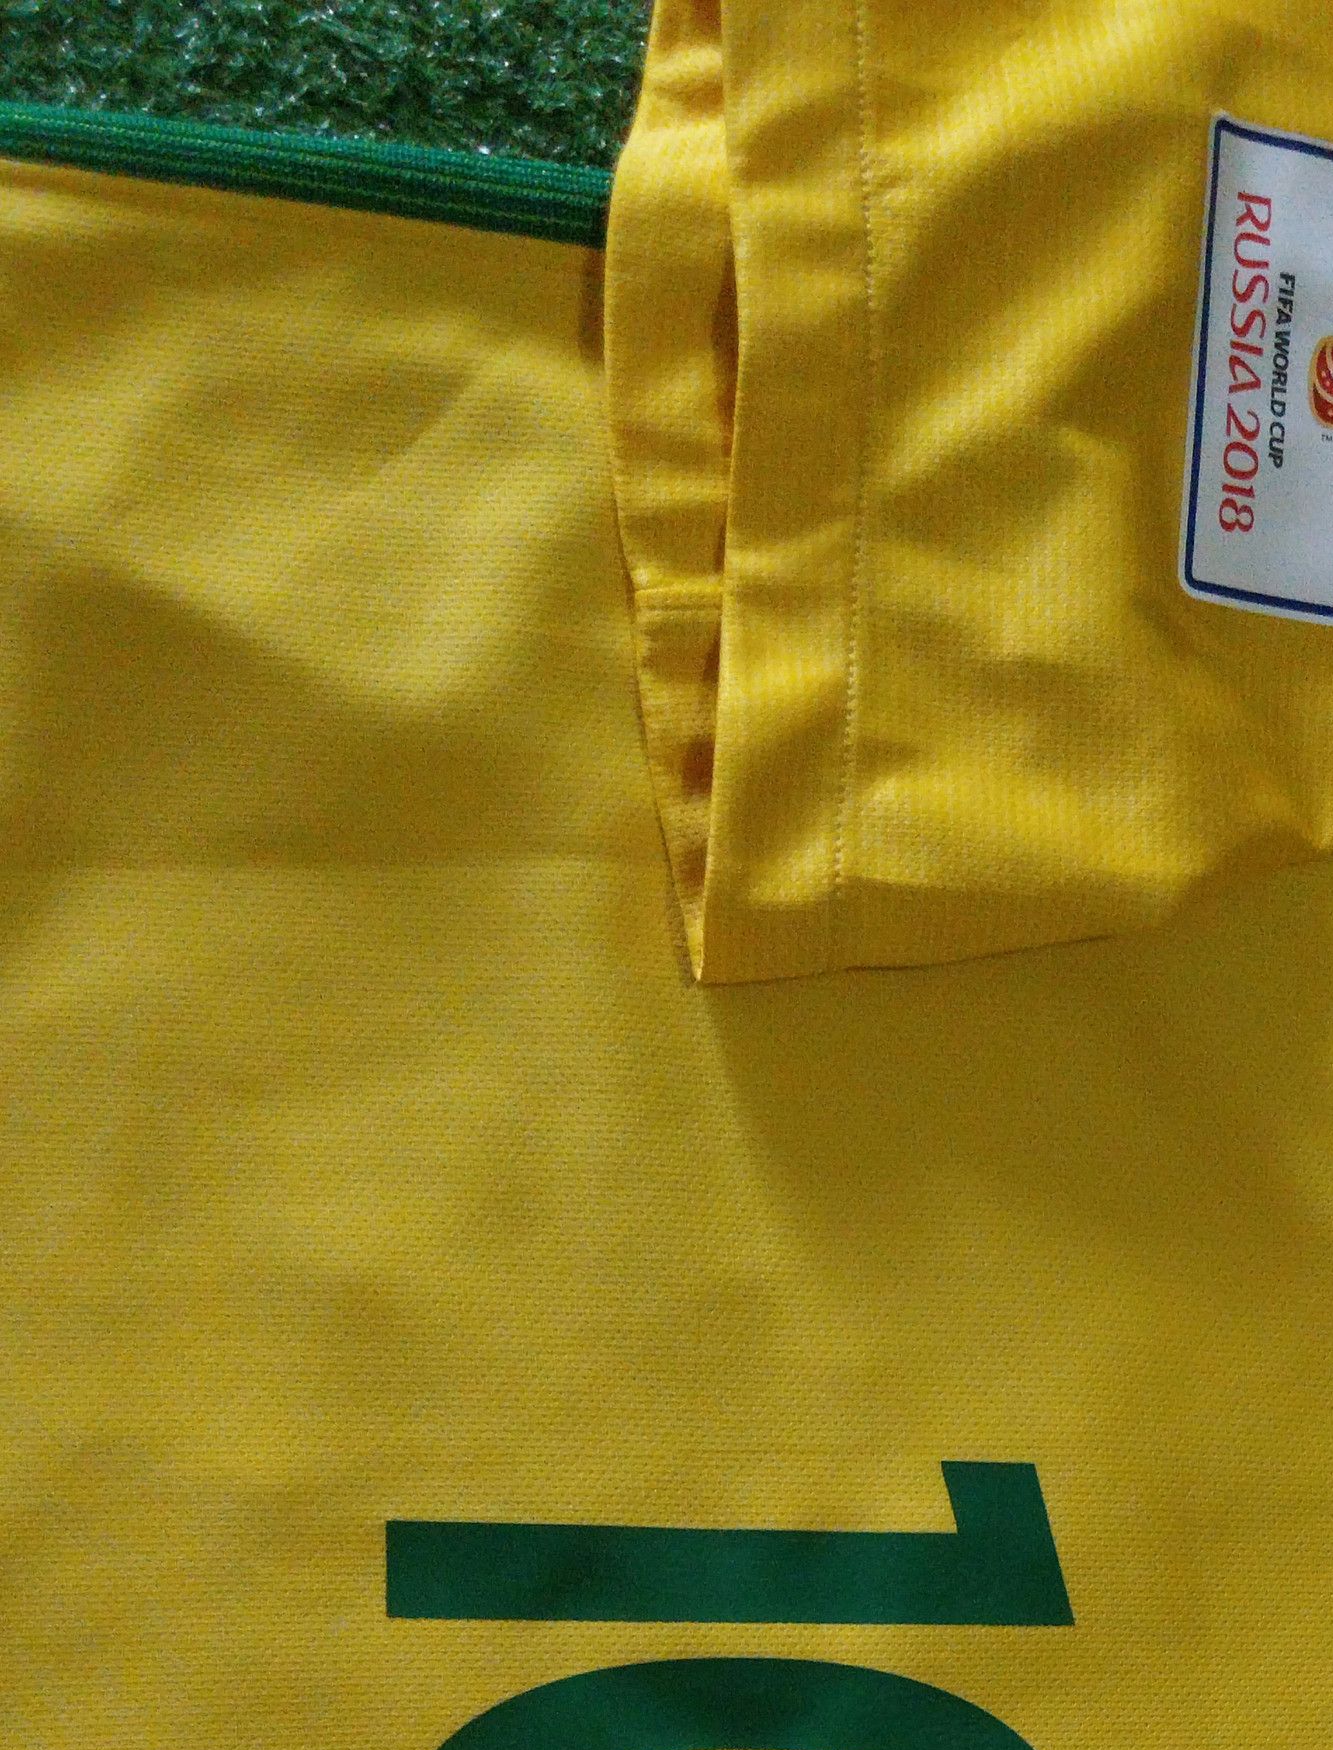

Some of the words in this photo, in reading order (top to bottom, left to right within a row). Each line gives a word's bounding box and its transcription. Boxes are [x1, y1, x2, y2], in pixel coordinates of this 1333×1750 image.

[1230, 192, 1272, 395] RUSSIA
[1275, 272, 1298, 327] FIFA
[1270, 330, 1292, 419] WORLD
[1219, 404, 1260, 533] 2018
[1268, 421, 1288, 469] CUP
